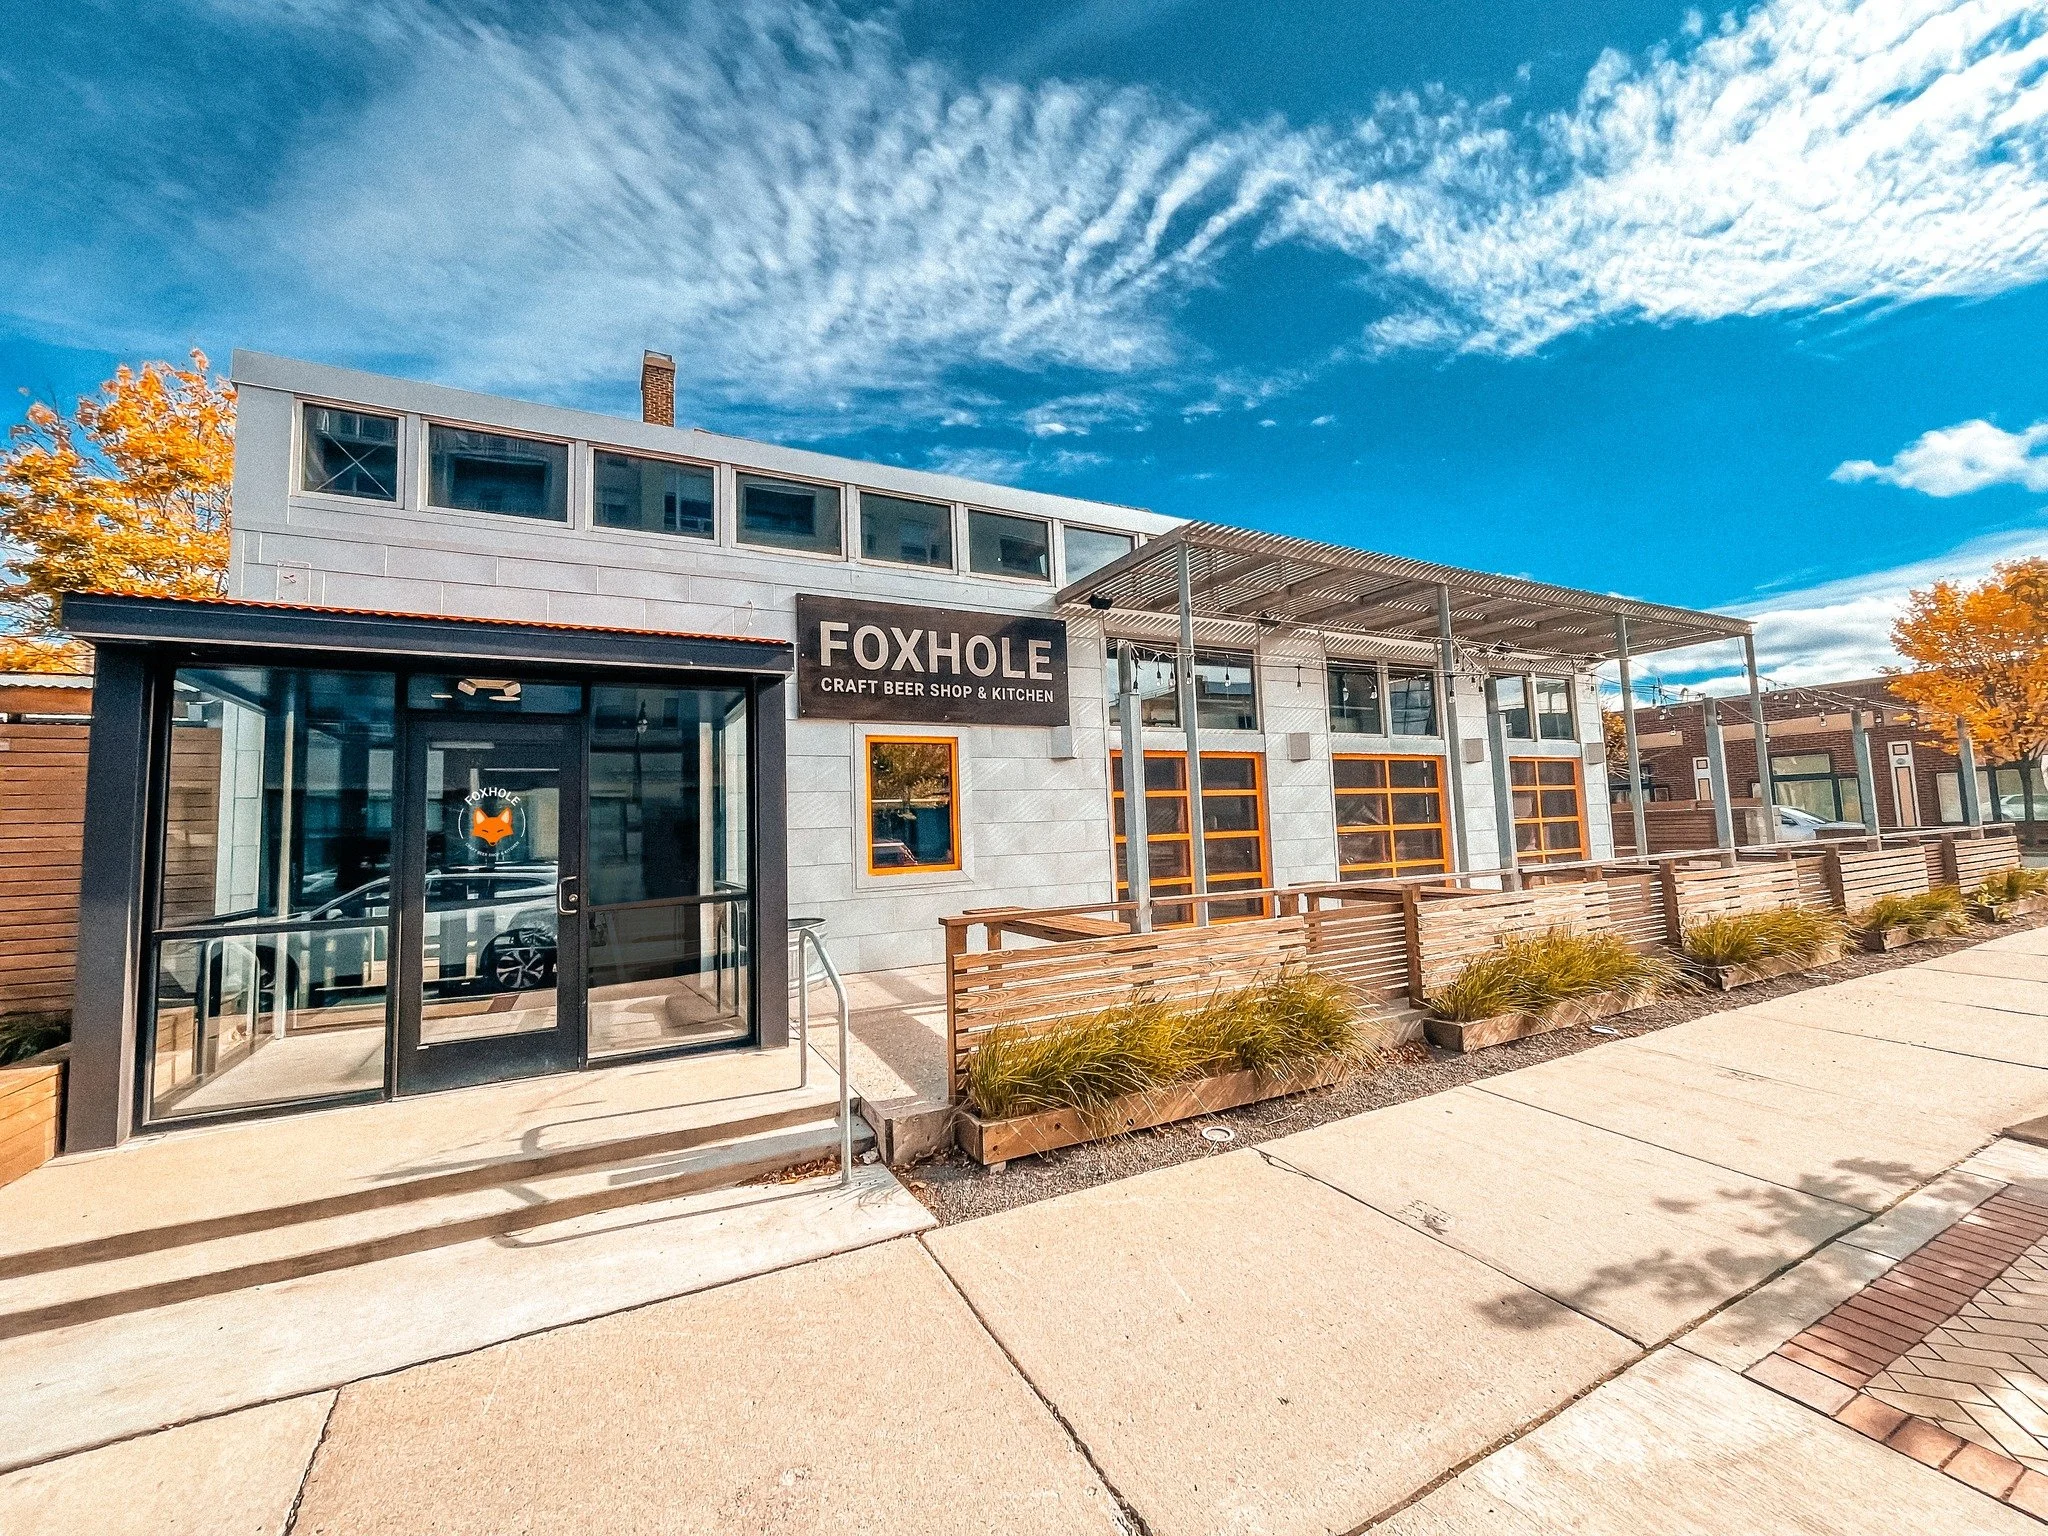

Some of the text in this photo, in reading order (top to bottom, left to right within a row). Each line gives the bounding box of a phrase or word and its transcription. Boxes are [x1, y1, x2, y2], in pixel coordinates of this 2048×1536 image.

[819, 620, 1053, 681] FOXHOLE
[821, 677, 1054, 703] CRAFT BEER SHOP & KITCHEN
[464, 786, 521, 806] FOXHOLE
